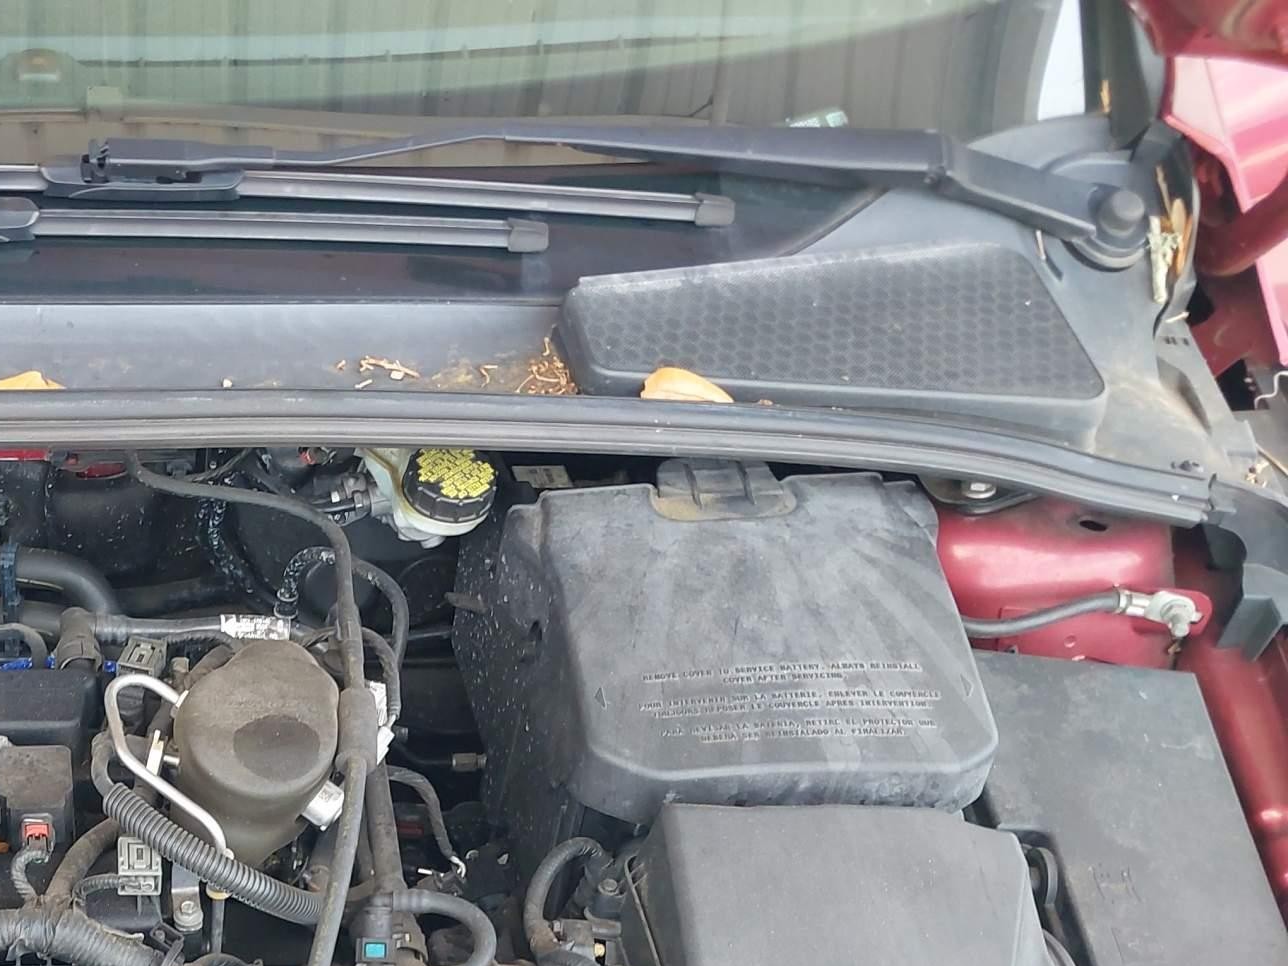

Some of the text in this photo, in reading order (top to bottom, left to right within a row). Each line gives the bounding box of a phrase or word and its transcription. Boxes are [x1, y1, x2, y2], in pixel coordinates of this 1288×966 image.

[641, 671, 676, 681] REMOVE
[683, 669, 712, 678] COVER
[719, 667, 730, 675] TO
[735, 665, 774, 673] SERVICE
[831, 662, 866, 670] ALWAYS
[870, 662, 920, 670] REINSTALL
[669, 696, 726, 706] INTERVENIR
[754, 693, 767, 701] LA
[828, 690, 869, 698] ENLEVER
[889, 690, 939, 698] COUVERCLE
[768, 701, 819, 709] COUVERCLE
[736, 722, 749, 730] LA
[863, 718, 913, 726] PROTECTOR
[765, 729, 830, 737] REINSTALADO
